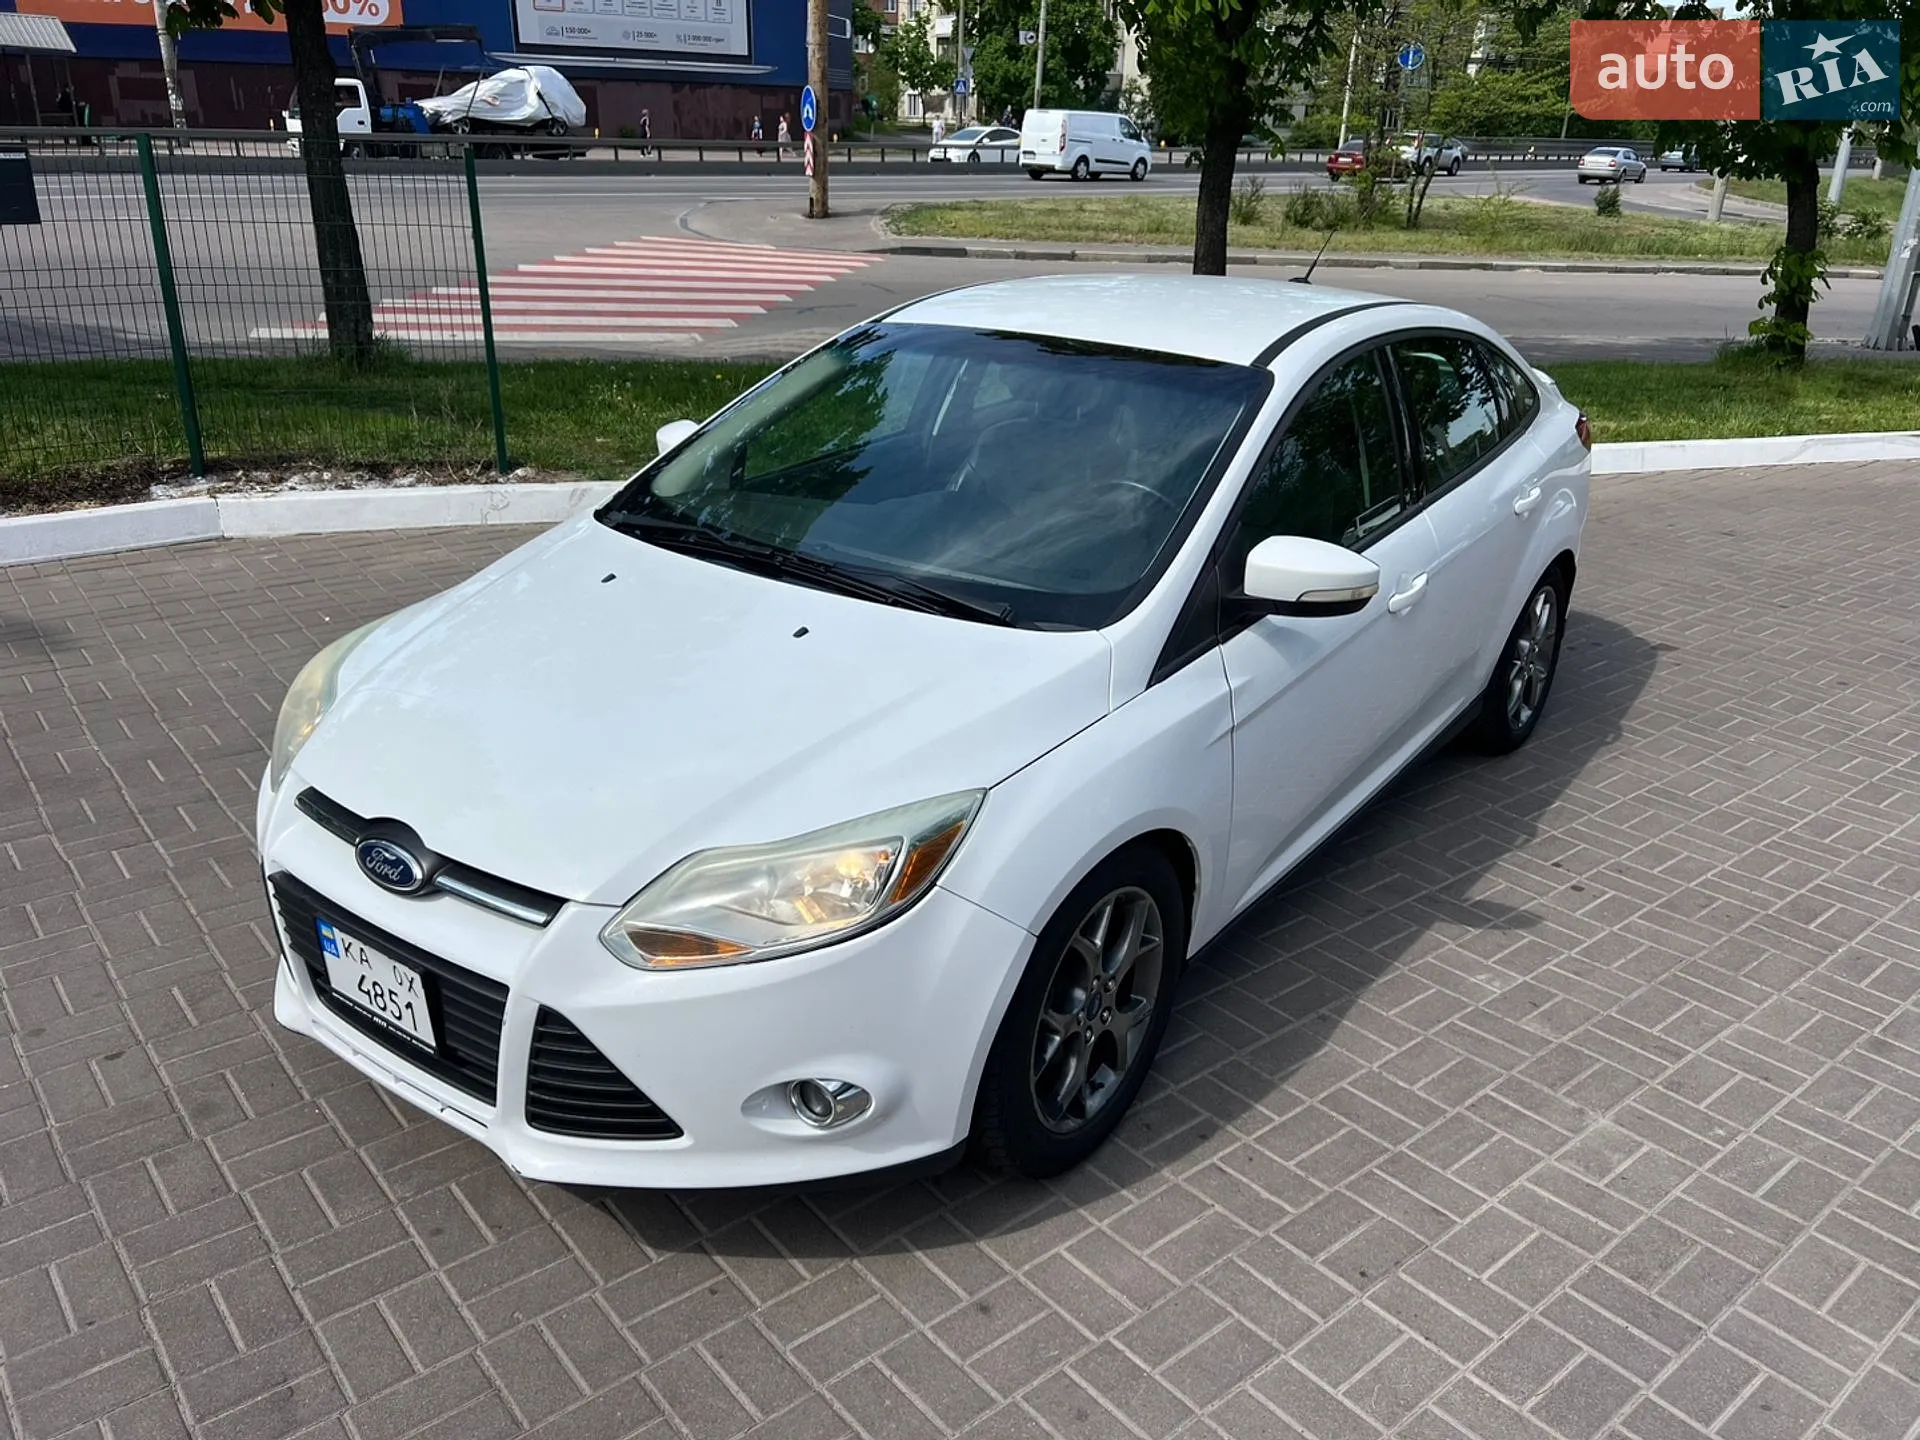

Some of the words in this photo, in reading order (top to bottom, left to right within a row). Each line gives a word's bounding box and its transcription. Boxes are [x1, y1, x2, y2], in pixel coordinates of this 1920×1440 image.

[366, 847, 404, 882] Ford
[341, 937, 373, 970] KA
[357, 974, 418, 1032] 4851
